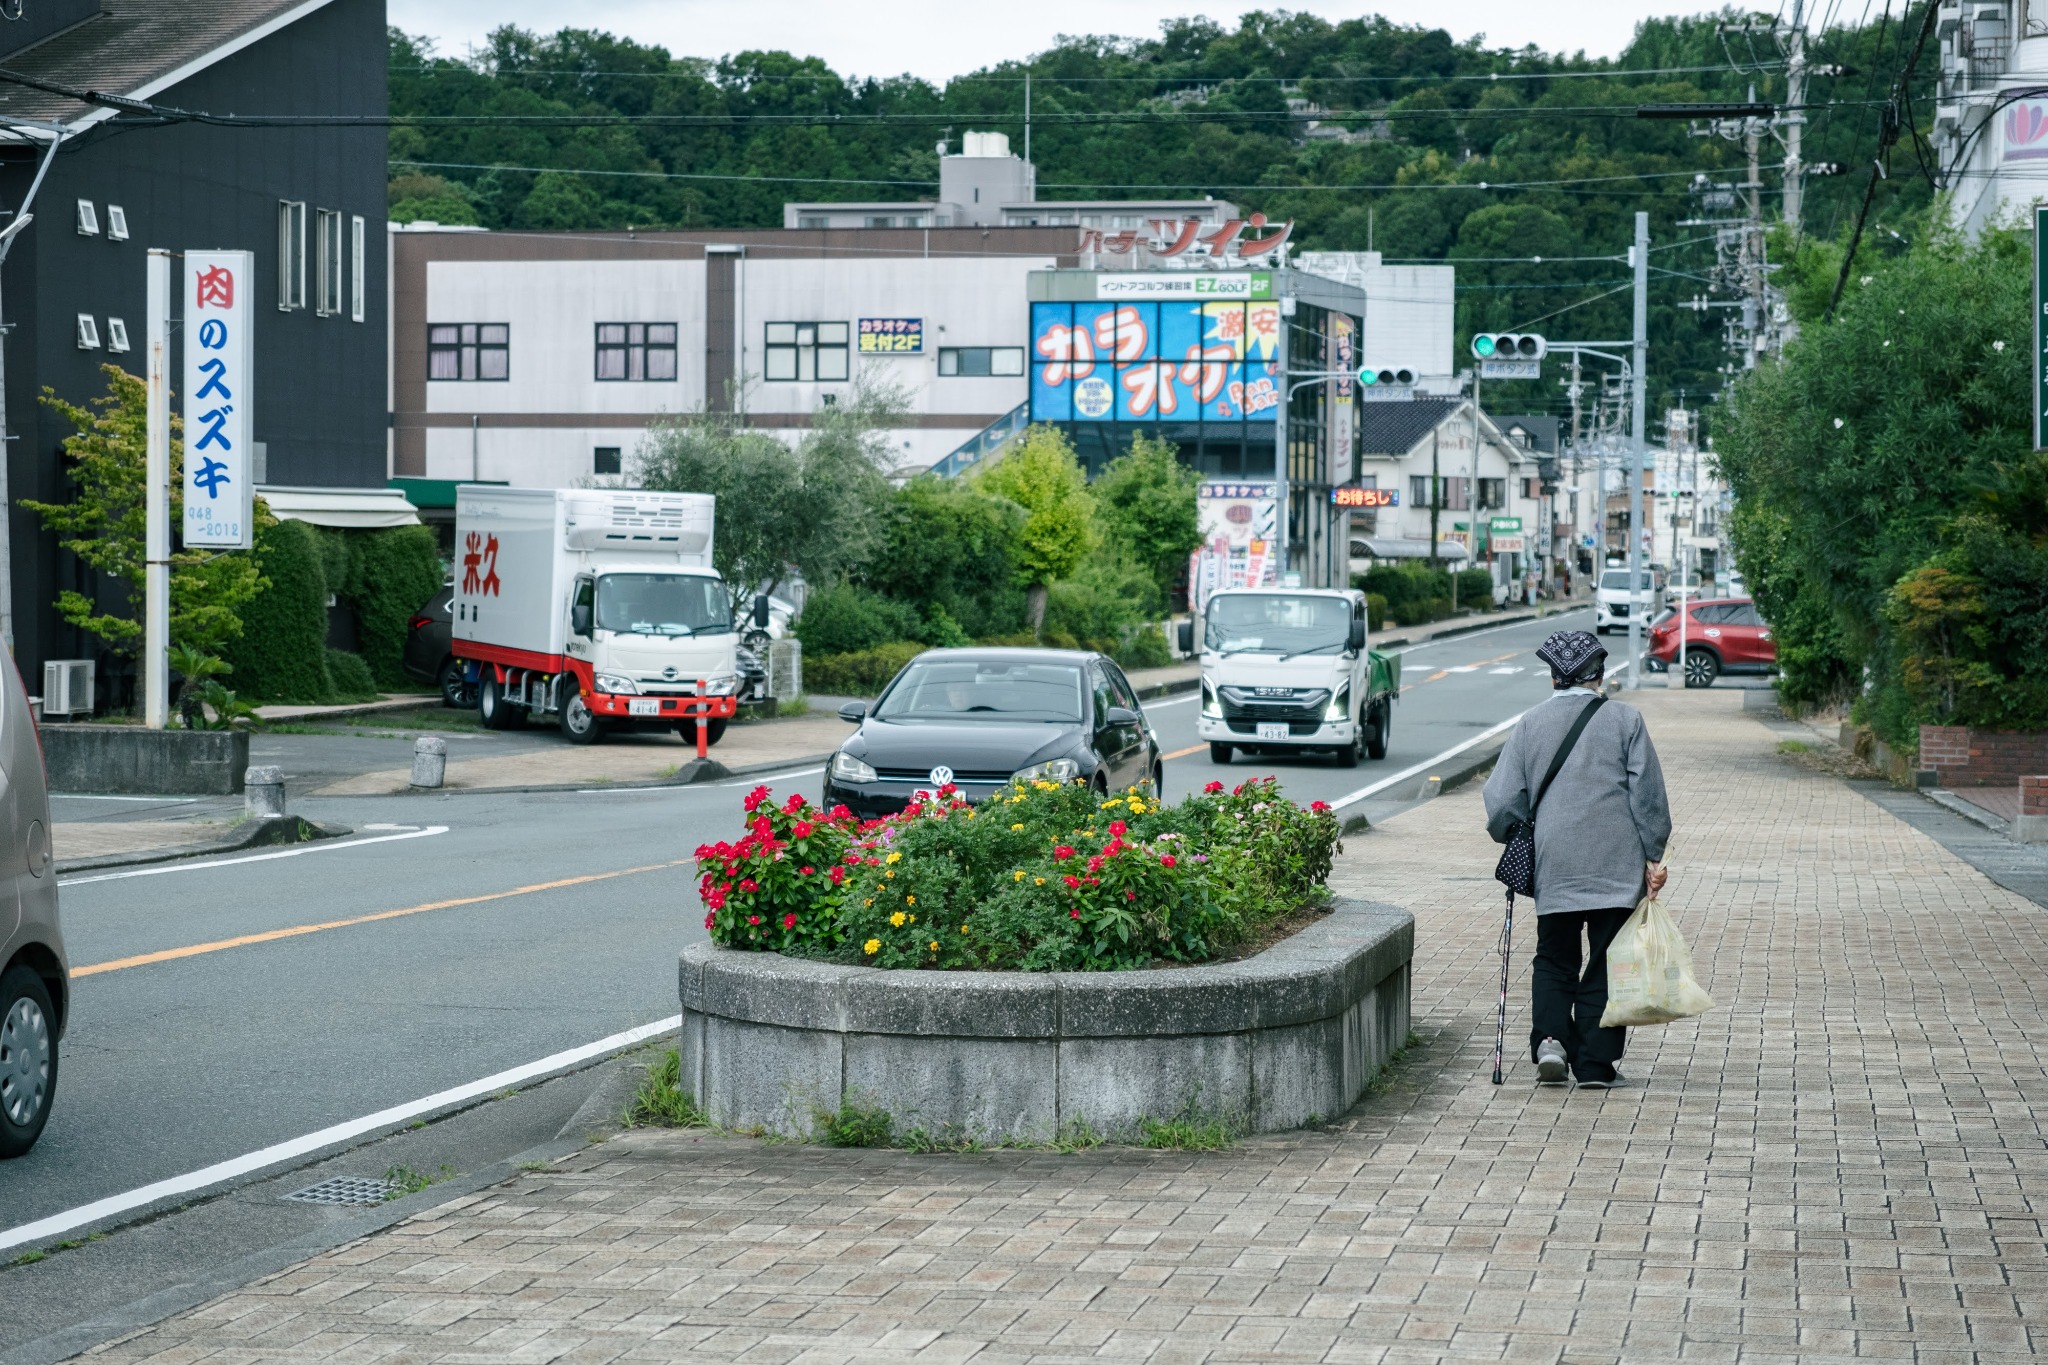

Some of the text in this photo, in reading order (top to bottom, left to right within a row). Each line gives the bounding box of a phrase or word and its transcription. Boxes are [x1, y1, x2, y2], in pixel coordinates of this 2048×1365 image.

[1195, 278, 1217, 293] EZ
[1219, 284, 1248, 292] GOLF
[1253, 280, 1269, 291] 2F
[860, 320, 908, 333] カラオケ
[860, 334, 921, 351] 受付2F
[1037, 306, 1236, 416] カラオケ
[1486, 362, 1538, 376] 押ボタン式
[195, 264, 233, 499] 肉のスズキ
[1367, 388, 1412, 400] 押ボタン式
[1255, 687, 1293, 697] ISUZU
